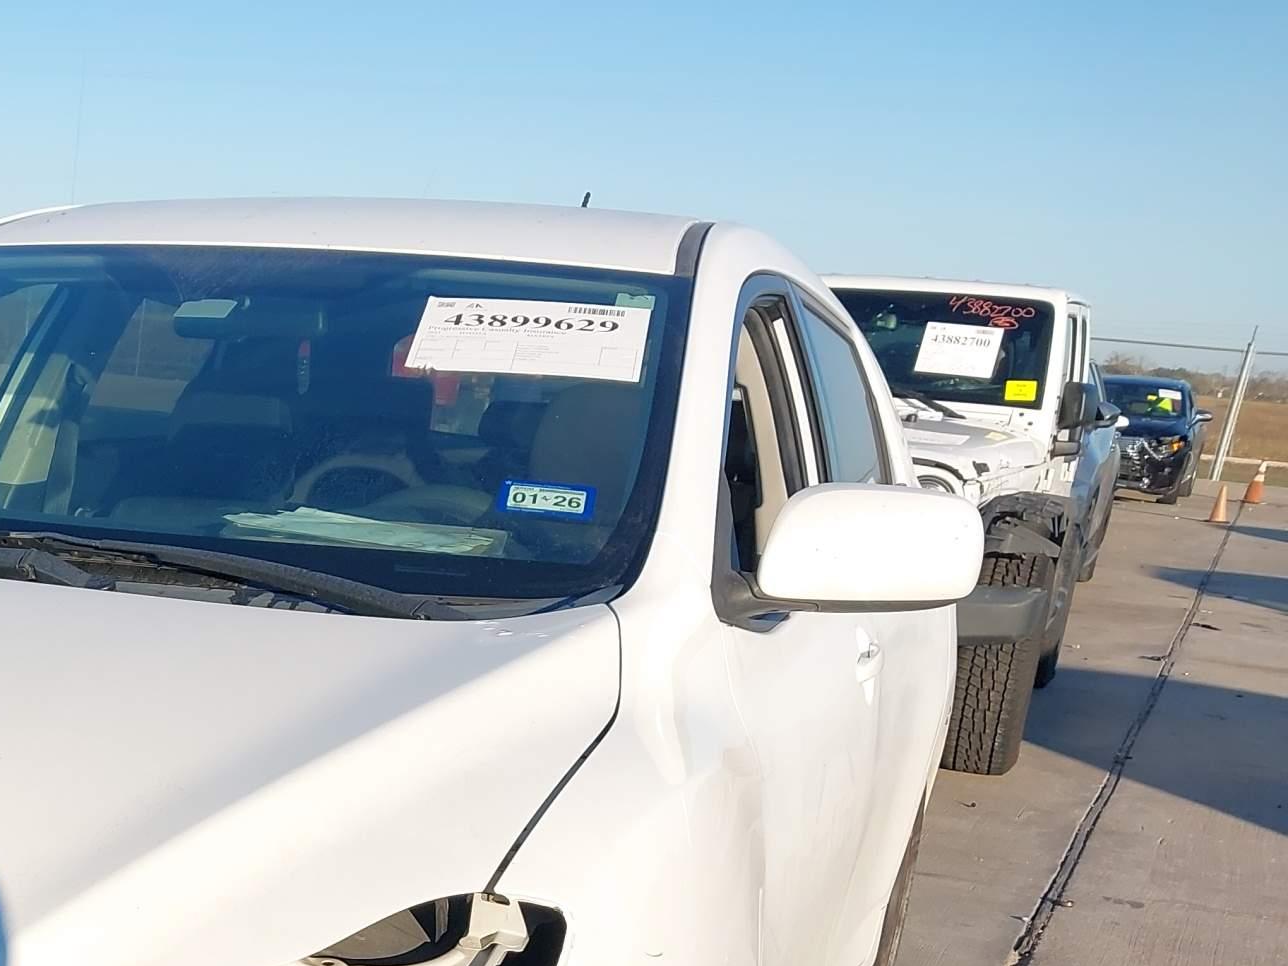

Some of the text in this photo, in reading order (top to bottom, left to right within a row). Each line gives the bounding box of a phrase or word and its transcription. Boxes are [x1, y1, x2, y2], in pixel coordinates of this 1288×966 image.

[949, 296, 1035, 317] 43882700
[444, 313, 619, 333] 43899629
[931, 334, 991, 348] 43882700
